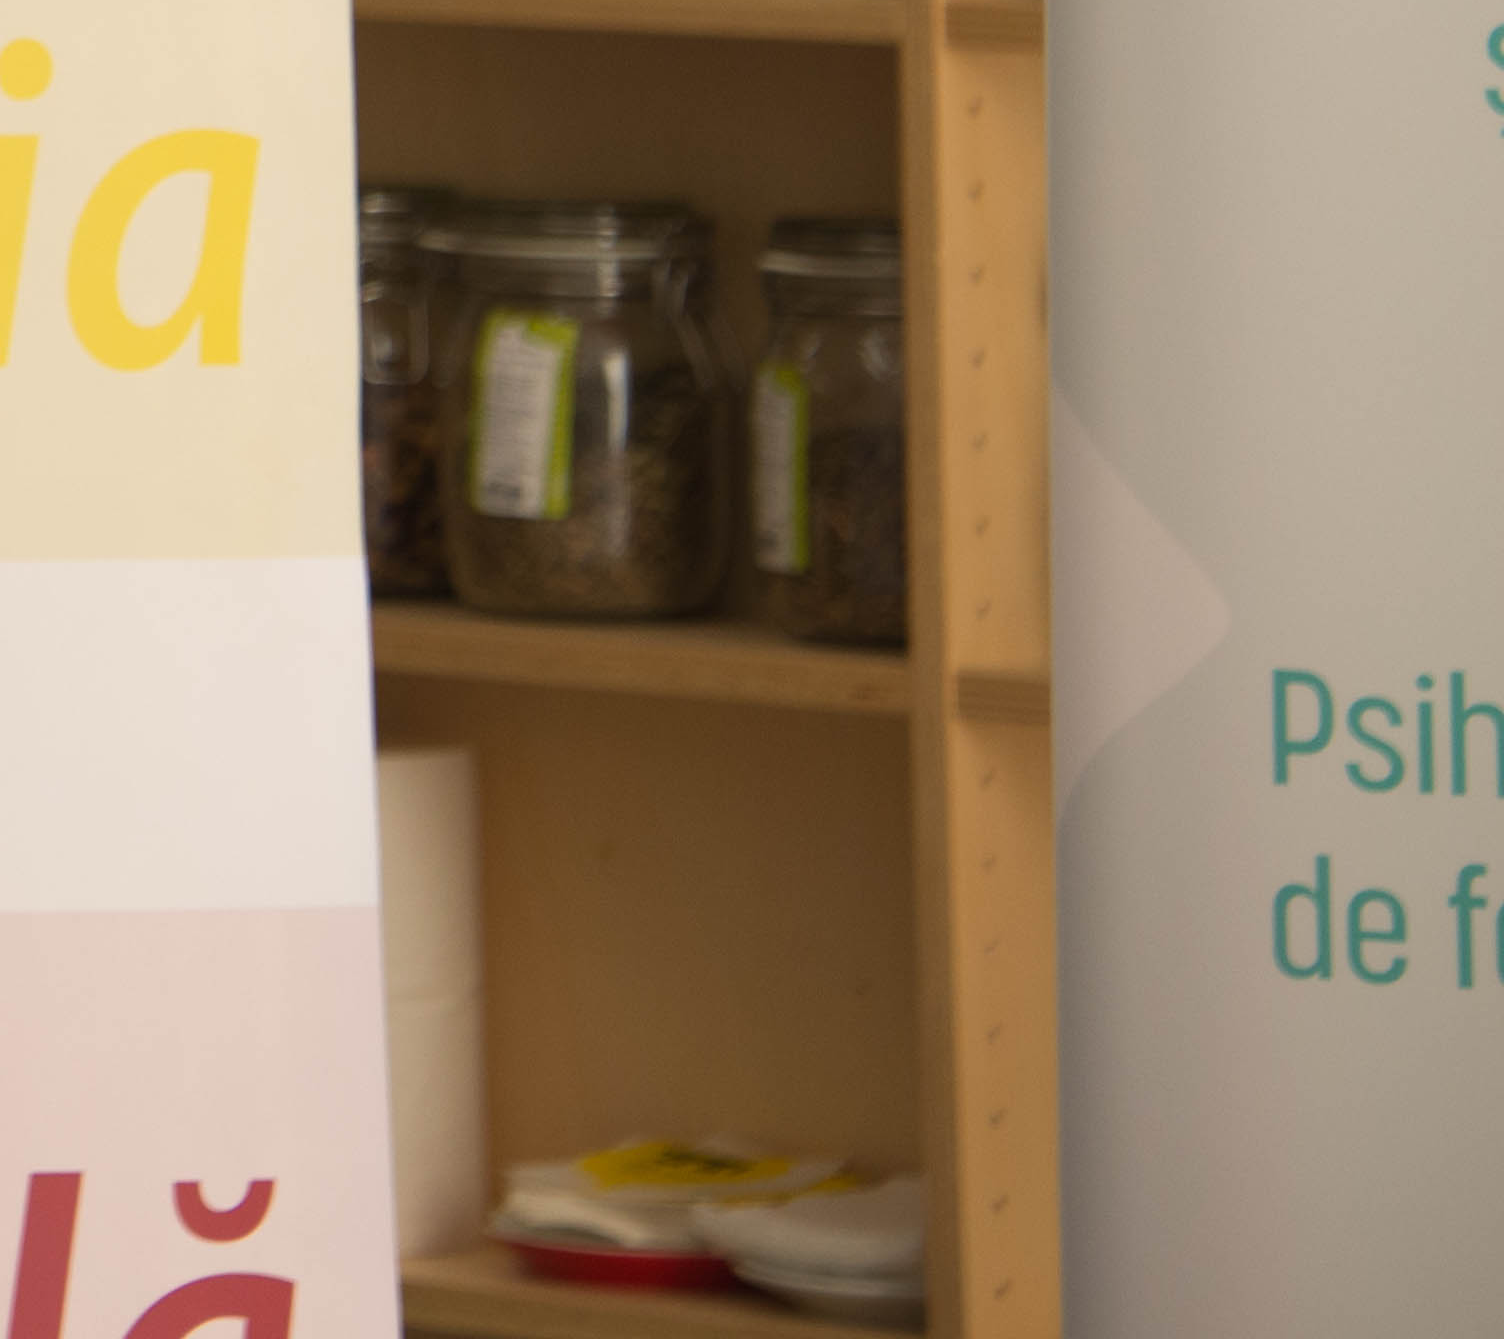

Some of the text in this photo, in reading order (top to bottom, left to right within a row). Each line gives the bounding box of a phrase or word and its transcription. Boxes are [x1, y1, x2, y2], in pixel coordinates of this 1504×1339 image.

[1271, 668, 1504, 800] Psih
[1271, 853, 1504, 991] de f
